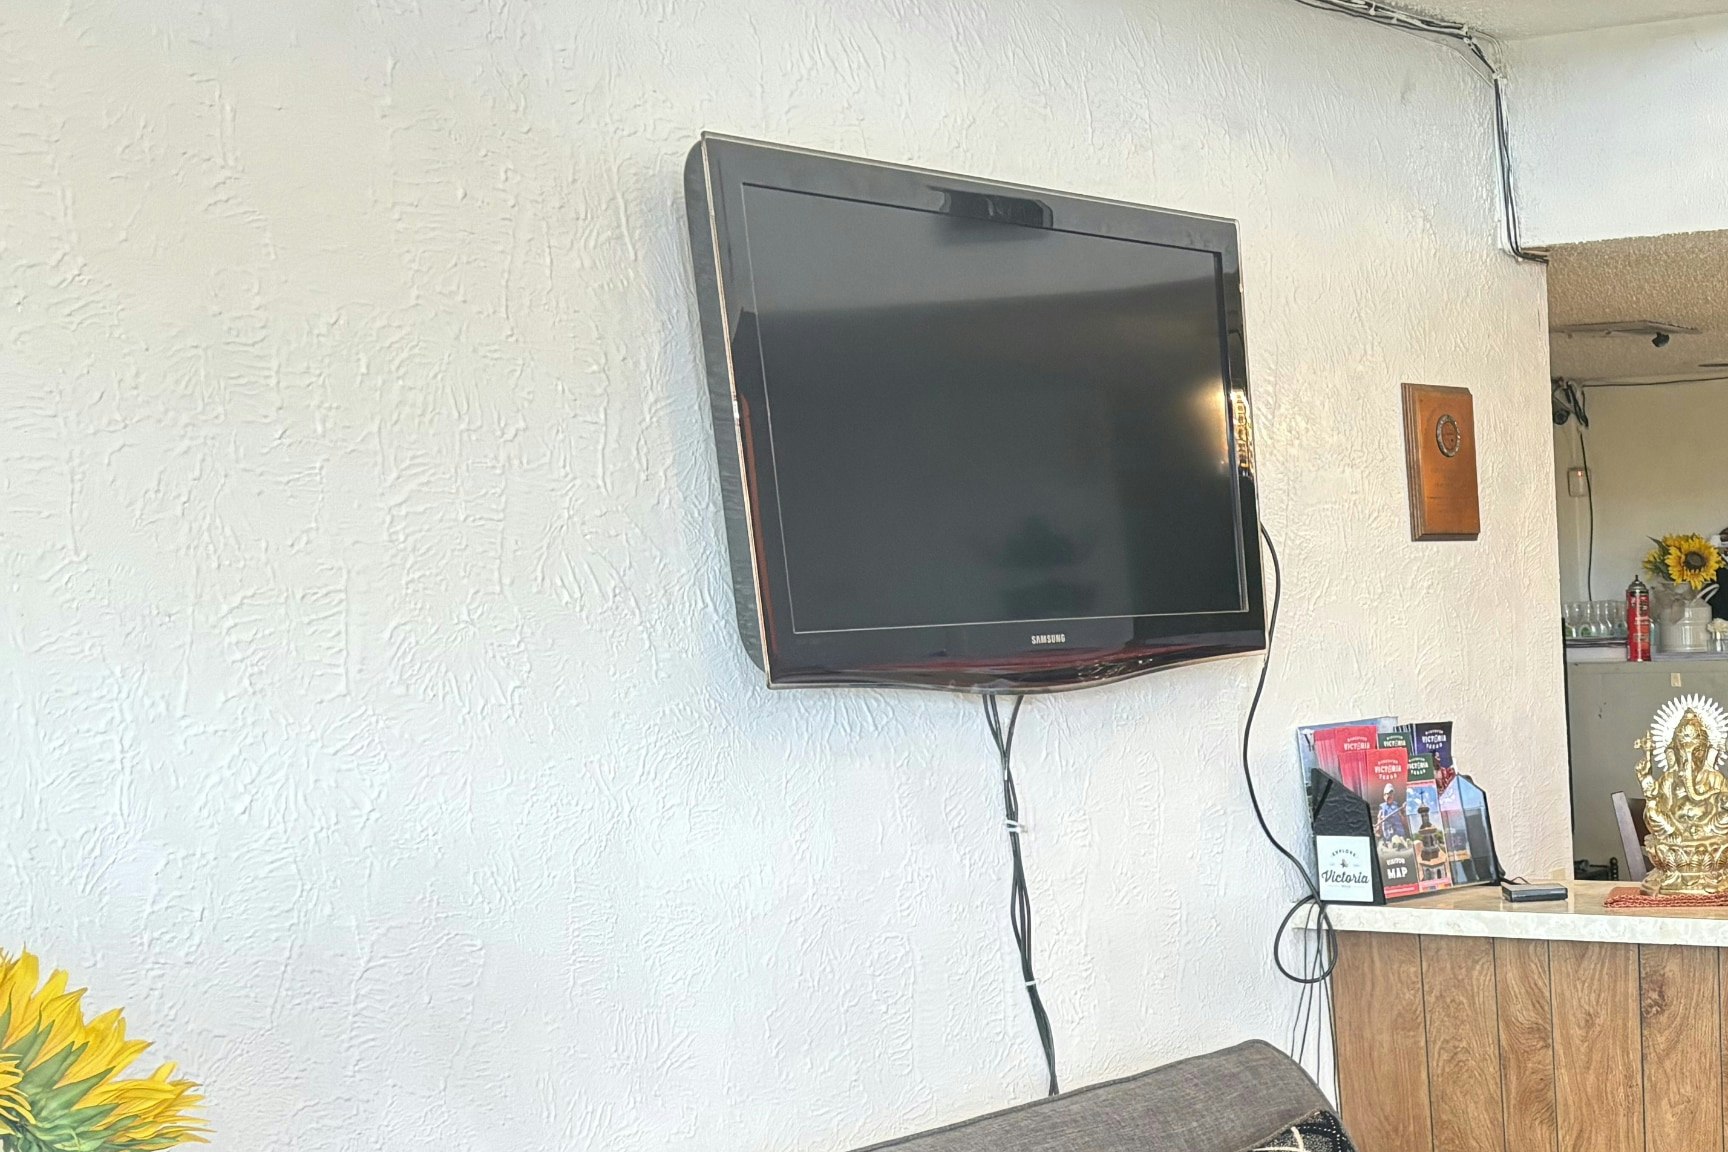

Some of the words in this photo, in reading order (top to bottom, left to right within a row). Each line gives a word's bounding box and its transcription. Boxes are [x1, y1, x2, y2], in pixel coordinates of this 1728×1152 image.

[1031, 633, 1066, 645] SAMSUNG
[1321, 869, 1370, 884] Victoria
[1387, 867, 1408, 879] MAP
